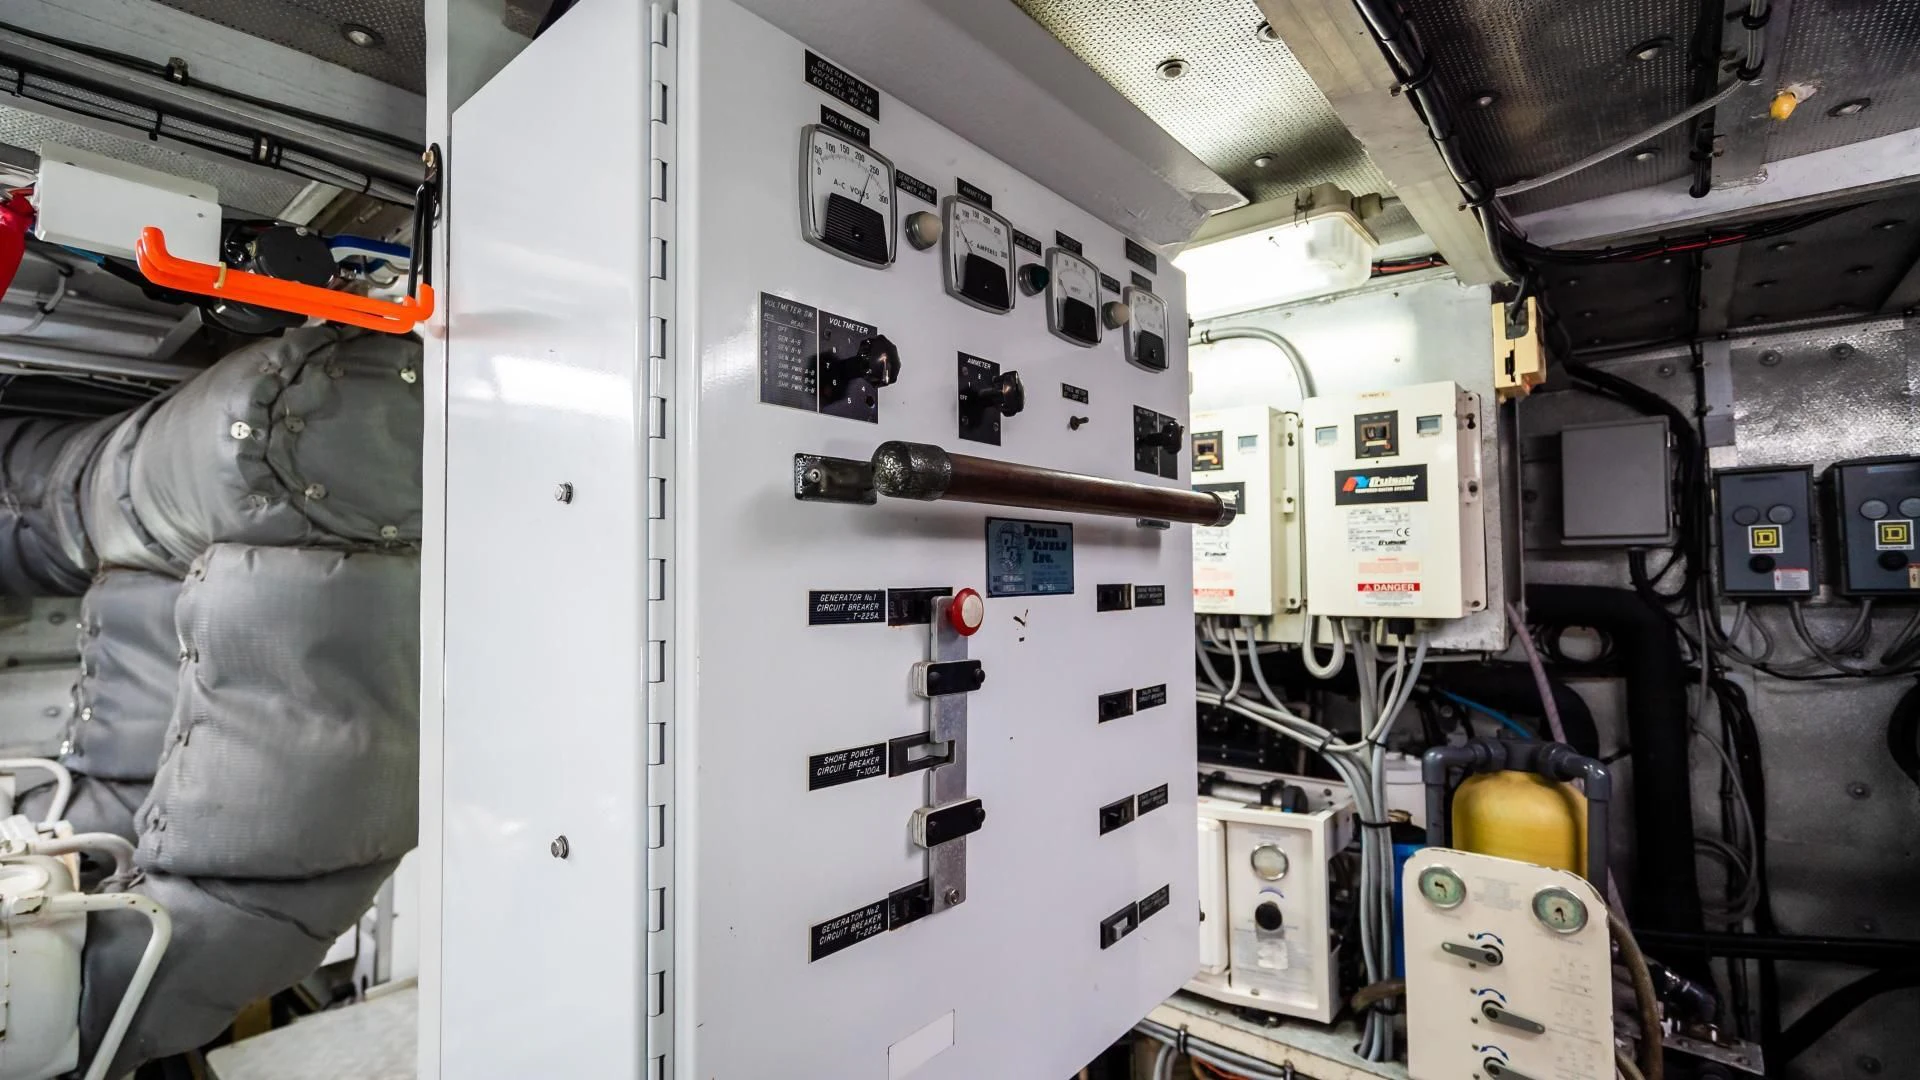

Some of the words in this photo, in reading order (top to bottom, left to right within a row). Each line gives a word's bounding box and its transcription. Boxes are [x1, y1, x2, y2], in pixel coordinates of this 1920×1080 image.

[817, 60, 856, 86] GENERATOR
[825, 82, 846, 98] CYCLE
[825, 113, 867, 138] VOLTMETER
[814, 145, 823, 156] 50
[825, 142, 836, 153] 100
[840, 143, 850, 155] 150
[854, 151, 865, 162] 200
[817, 166, 822, 175] 0
[869, 164, 880, 176] 250
[878, 193, 889, 205] 300
[976, 243, 998, 257] AMPERES
[764, 298, 801, 315] VOLTMETER
[829, 317, 869, 334] VOLTMETER
[967, 357, 992, 369] AMMETER
[1374, 583, 1415, 592] DANGER
[820, 593, 862, 602] GENERATOR
[816, 603, 846, 612] CIRCUIT
[847, 603, 880, 611] BREAKER
[823, 752, 849, 765] SHORE
[850, 748, 875, 760] POWER
[816, 762, 847, 776] CIRCUIT
[848, 756, 880, 770] BREAKER
[821, 909, 865, 934] GENERATOR
[819, 927, 849, 946] CIRCUIT
[850, 914, 883, 933] BREAKER
